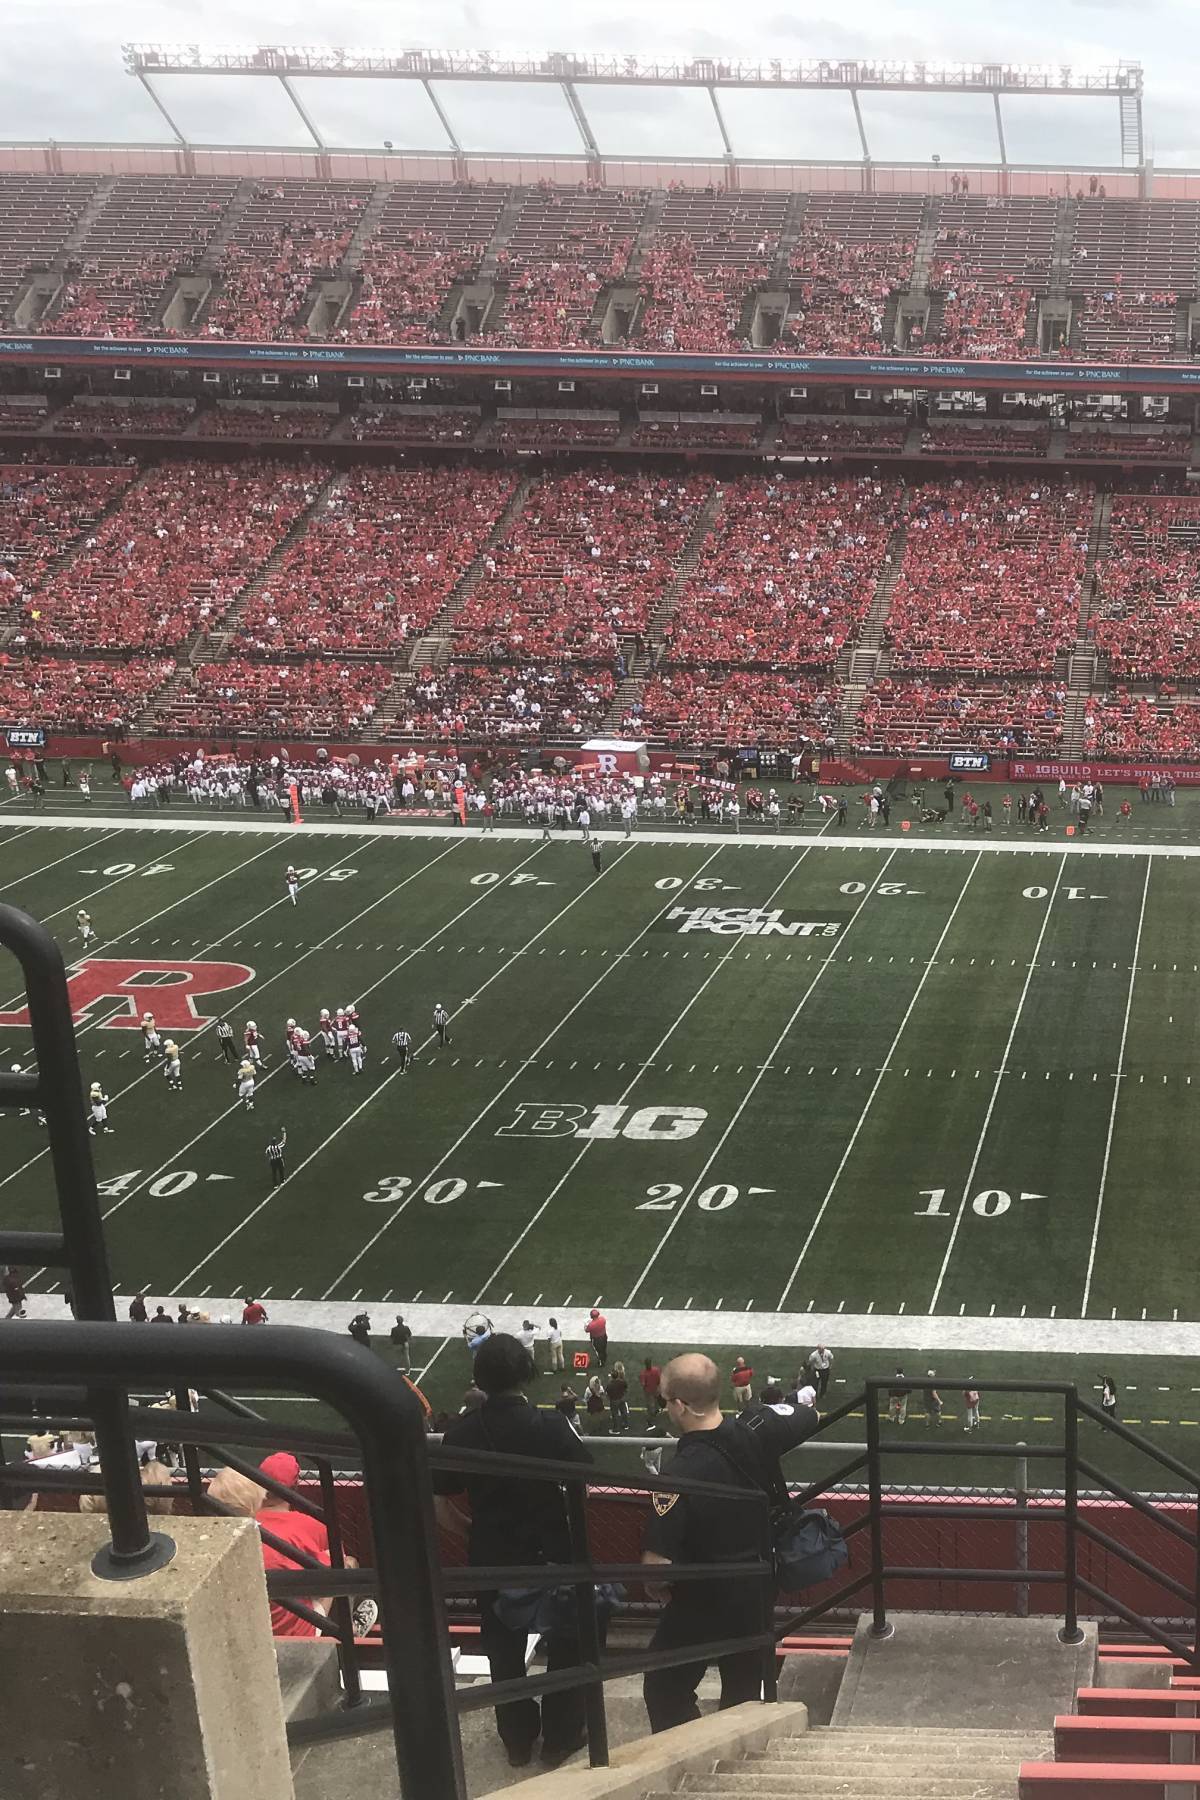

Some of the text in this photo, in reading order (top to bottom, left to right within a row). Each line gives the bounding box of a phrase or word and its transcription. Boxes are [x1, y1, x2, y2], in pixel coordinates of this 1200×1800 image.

[10, 732, 39, 743] BTN
[597, 754, 620, 772] R
[953, 757, 984, 767] BTN
[1014, 764, 1025, 773] R
[1097, 768, 1131, 776] LET'S
[665, 906, 785, 922] HIGH
[0, 958, 257, 1031] R
[97, 1169, 198, 1197] 40
[362, 1175, 468, 1204] 30
[634, 1182, 739, 1210] 20
[913, 1187, 1011, 1216] 10
[575, 1355, 587, 1366] 20
